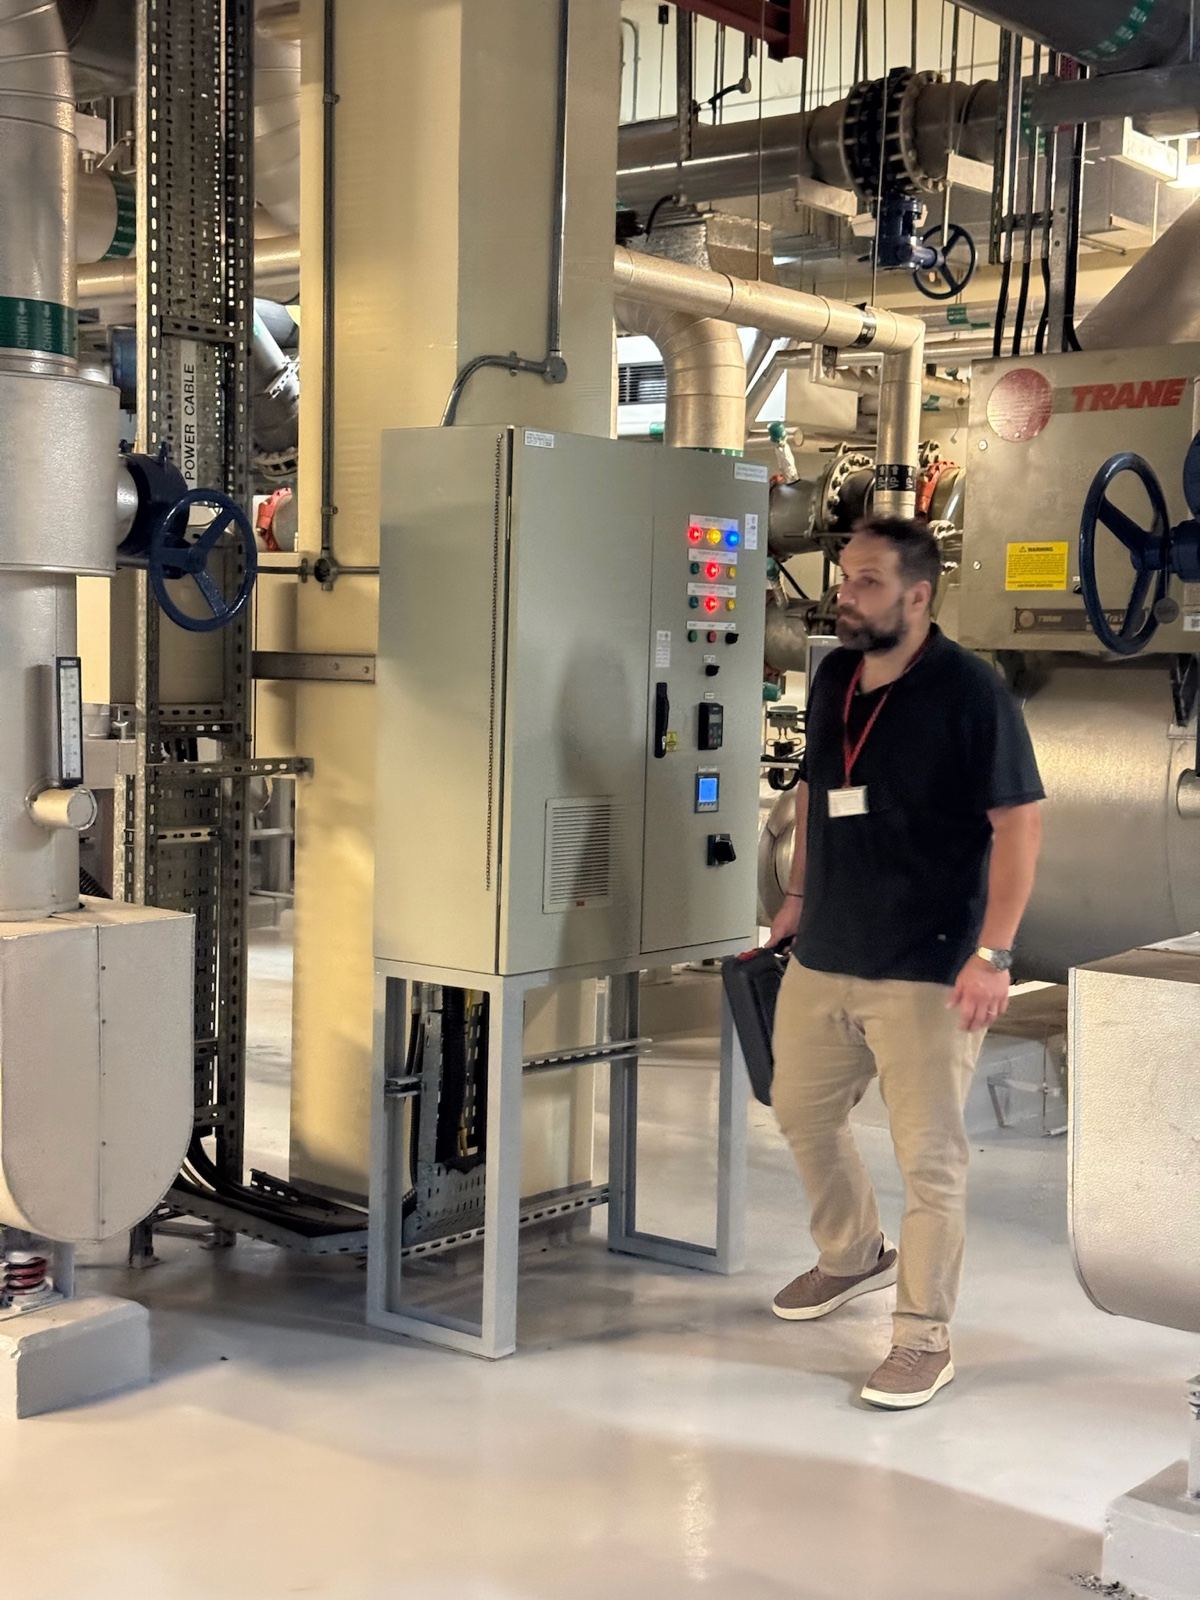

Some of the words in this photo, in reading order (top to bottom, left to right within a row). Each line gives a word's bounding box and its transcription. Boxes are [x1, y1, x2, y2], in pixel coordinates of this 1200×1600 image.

[184, 363, 195, 416] CABLE
[1072, 378, 1187, 412] TRANE
[184, 423, 195, 480] POWER
[889, 476, 900, 489] VP
[905, 477, 913, 489] VP
